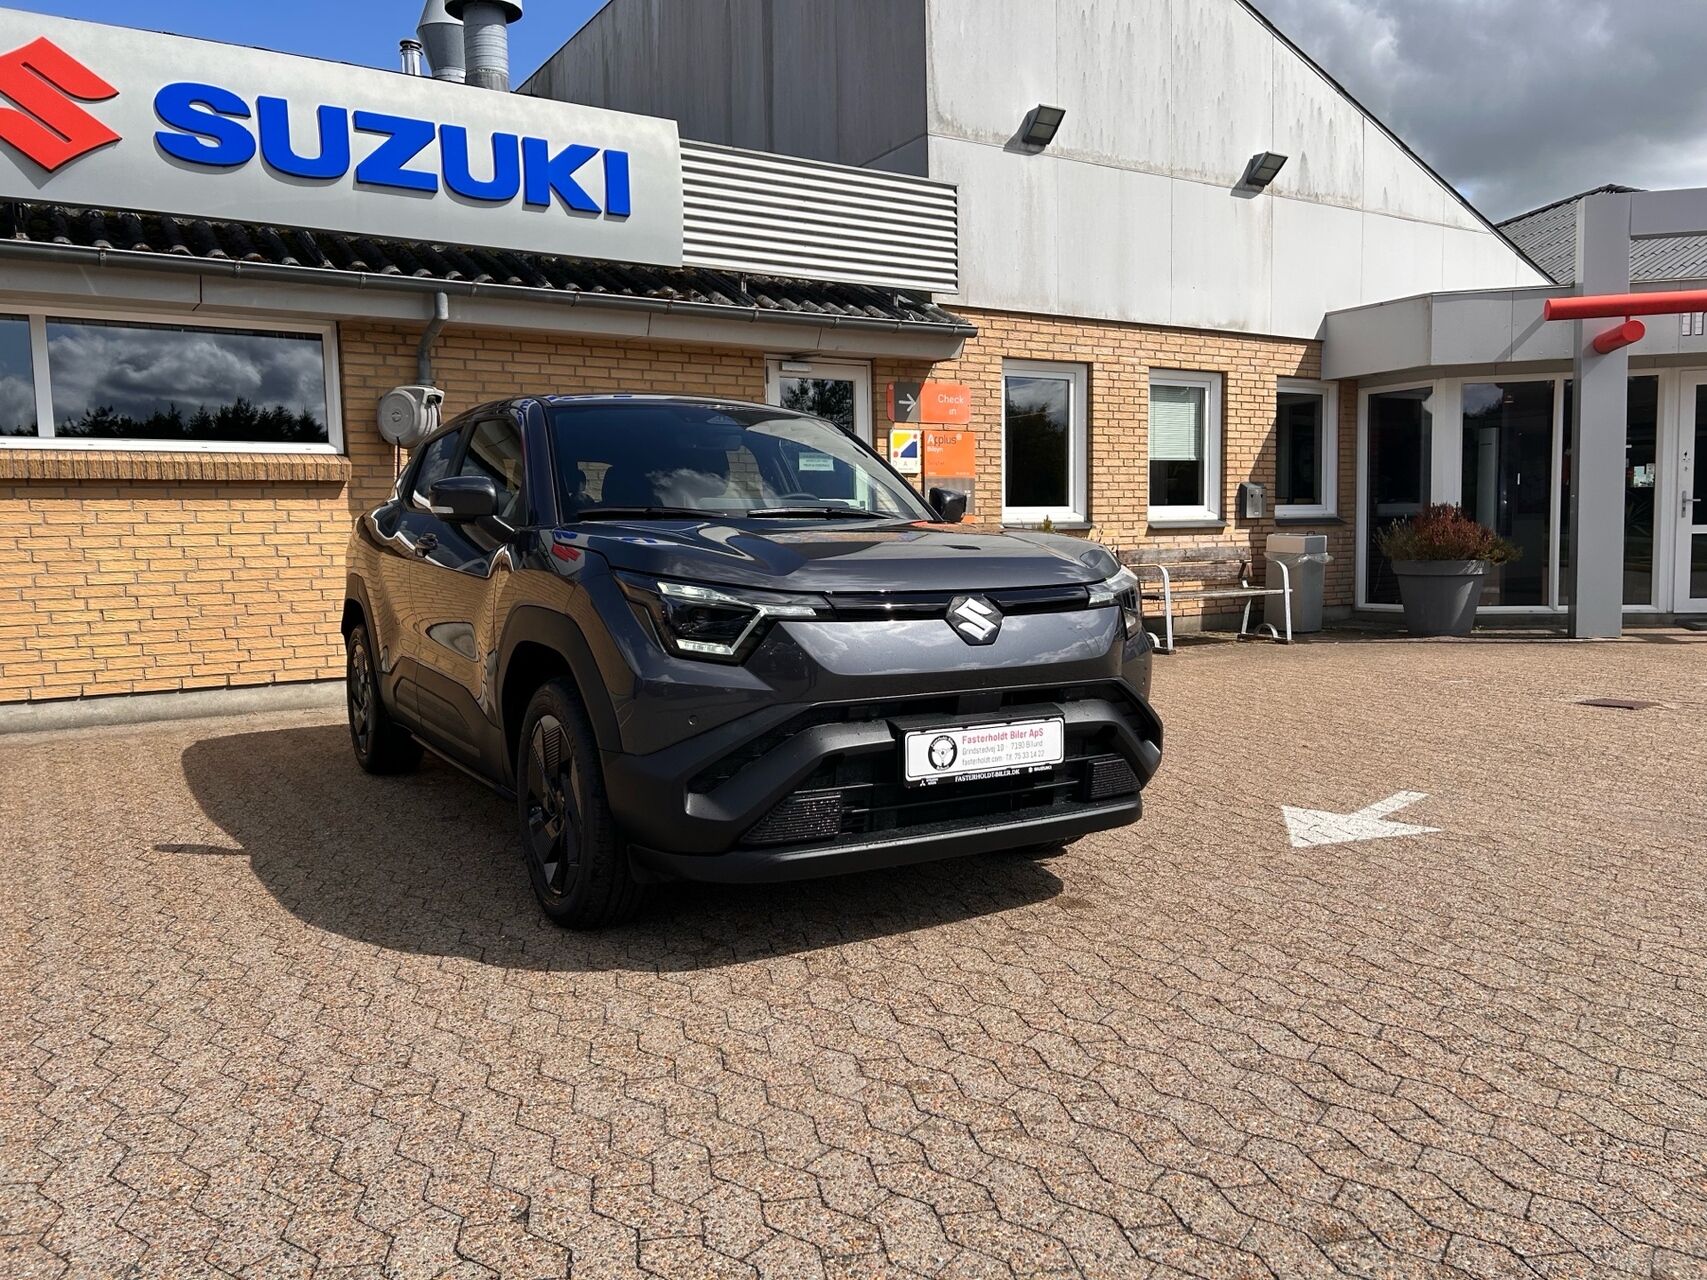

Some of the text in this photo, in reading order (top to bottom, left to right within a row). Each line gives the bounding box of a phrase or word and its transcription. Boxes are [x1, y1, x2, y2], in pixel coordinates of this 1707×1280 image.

[153, 81, 631, 217] SUZUKI
[937, 393, 964, 405] Check
[927, 433, 957, 447] Applus
[962, 727, 1044, 745] Fasterholdt Biler ApS
